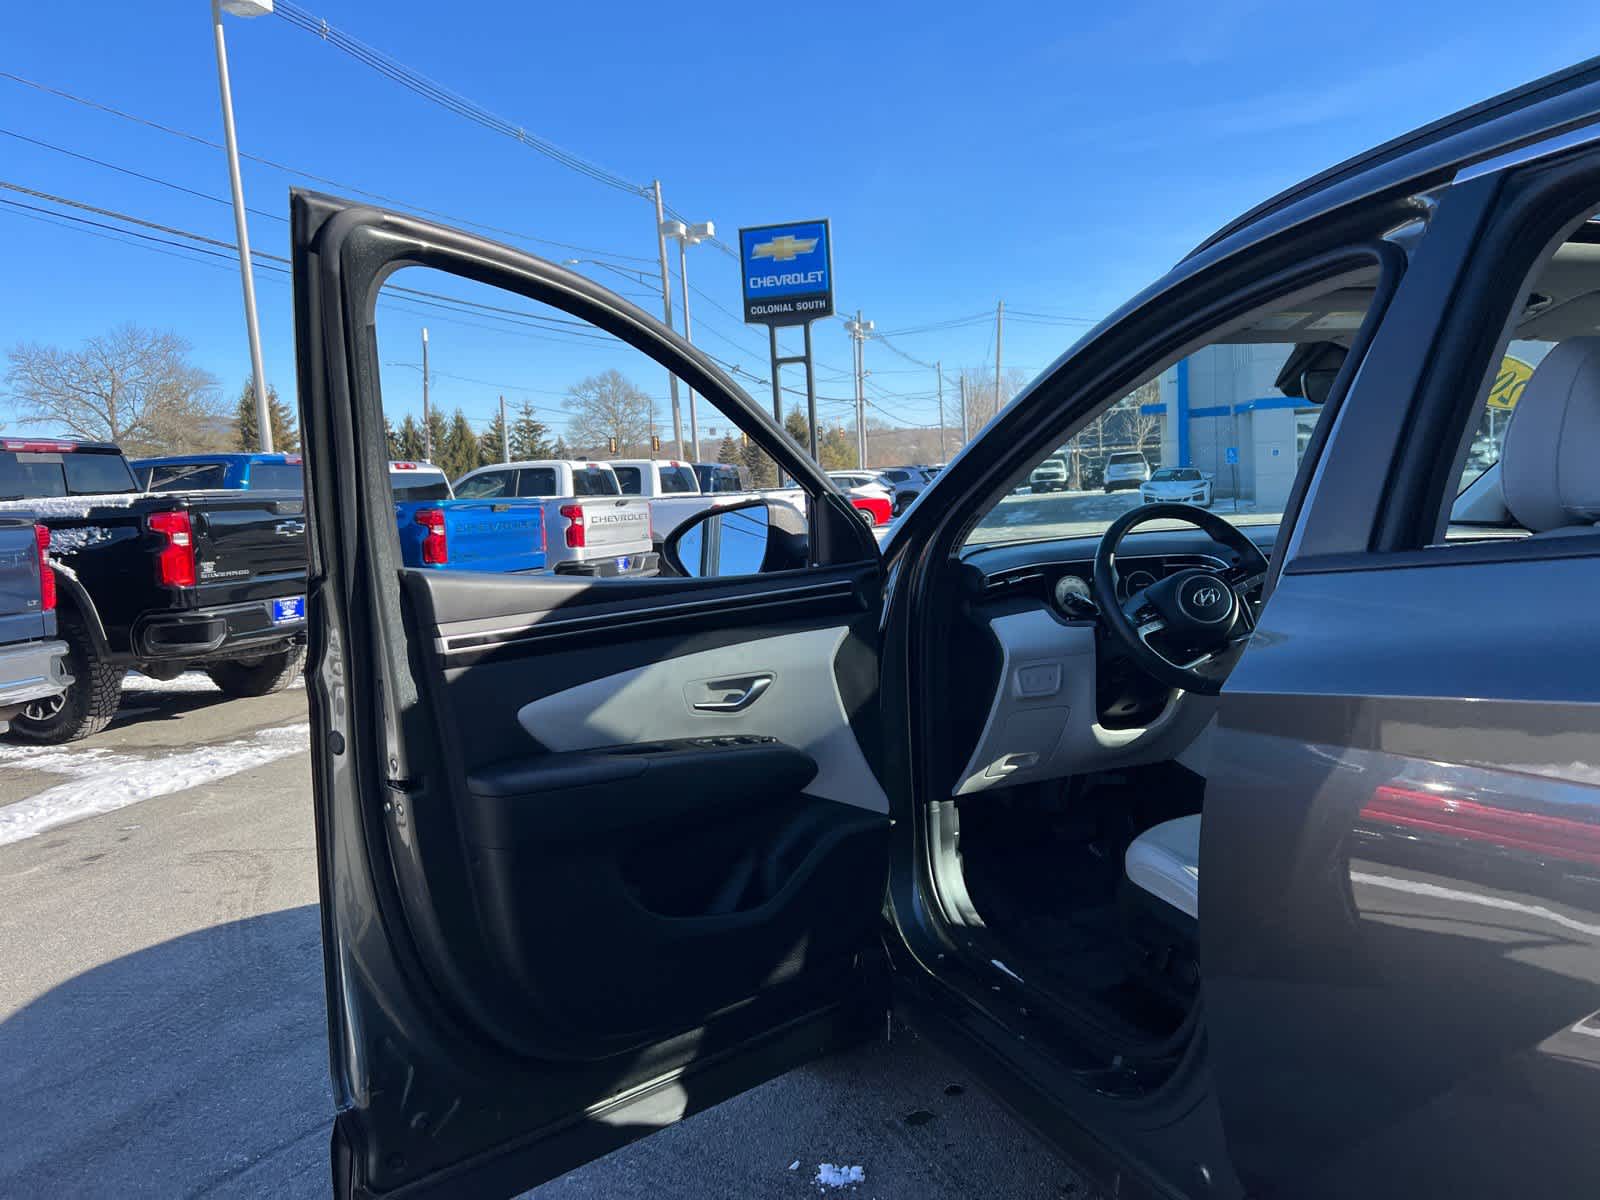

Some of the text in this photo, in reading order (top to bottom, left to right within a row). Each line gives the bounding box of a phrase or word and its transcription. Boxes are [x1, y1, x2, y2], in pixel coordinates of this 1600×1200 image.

[750, 270, 824, 288] CHEVROLET
[750, 300, 826, 315] COLONIAL SOUTH
[591, 513, 649, 524] CHEVROLET
